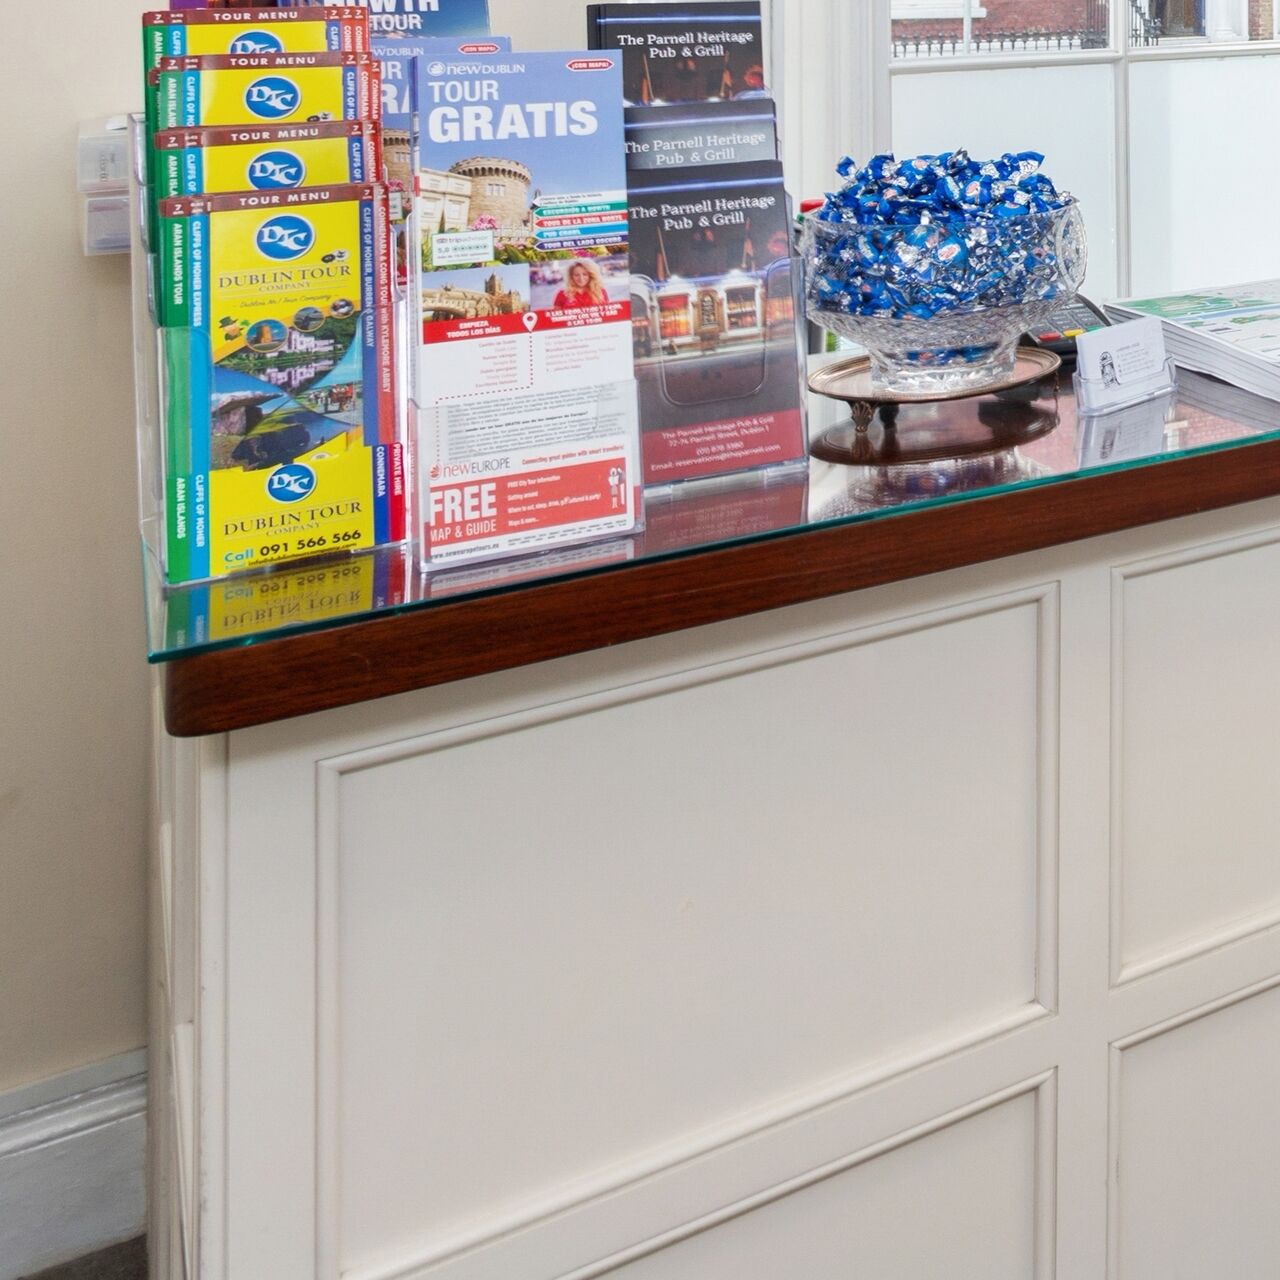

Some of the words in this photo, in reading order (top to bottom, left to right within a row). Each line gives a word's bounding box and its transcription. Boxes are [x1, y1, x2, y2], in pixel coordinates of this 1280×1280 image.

[214, 12, 251, 20] TOUR
[258, 12, 298, 20] MENU
[369, 14, 422, 30] TOUR
[617, 34, 644, 46] The
[648, 33, 694, 45] Parnell
[698, 31, 753, 45] Heritage
[650, 47, 676, 58] Pub
[682, 47, 691, 57] &
[695, 45, 724, 57] Grill
[428, 80, 499, 103] TOUR
[429, 100, 598, 144] GRATIS
[231, 132, 270, 141] TOUR
[278, 128, 318, 138] MENU
[240, 195, 280, 206] TOUR
[288, 191, 330, 202] MENU
[629, 207, 658, 219] The
[661, 199, 712, 216] Parnell
[715, 195, 776, 211] Heritage
[664, 218, 693, 231] Pub
[699, 216, 710, 227] &
[713, 212, 744, 225] Grill
[219, 271, 293, 289] DUBLIN
[299, 265, 351, 280] TOUR
[258, 281, 311, 293] COMPANY
[440, 457, 511, 478] newEUROPE
[430, 482, 497, 527] FREE
[455, 525, 463, 537] &
[466, 521, 497, 536] GUIDE
[225, 549, 254, 563] Call
[260, 542, 289, 557] 091
[297, 537, 327, 550] 566
[332, 530, 361, 544] 566
